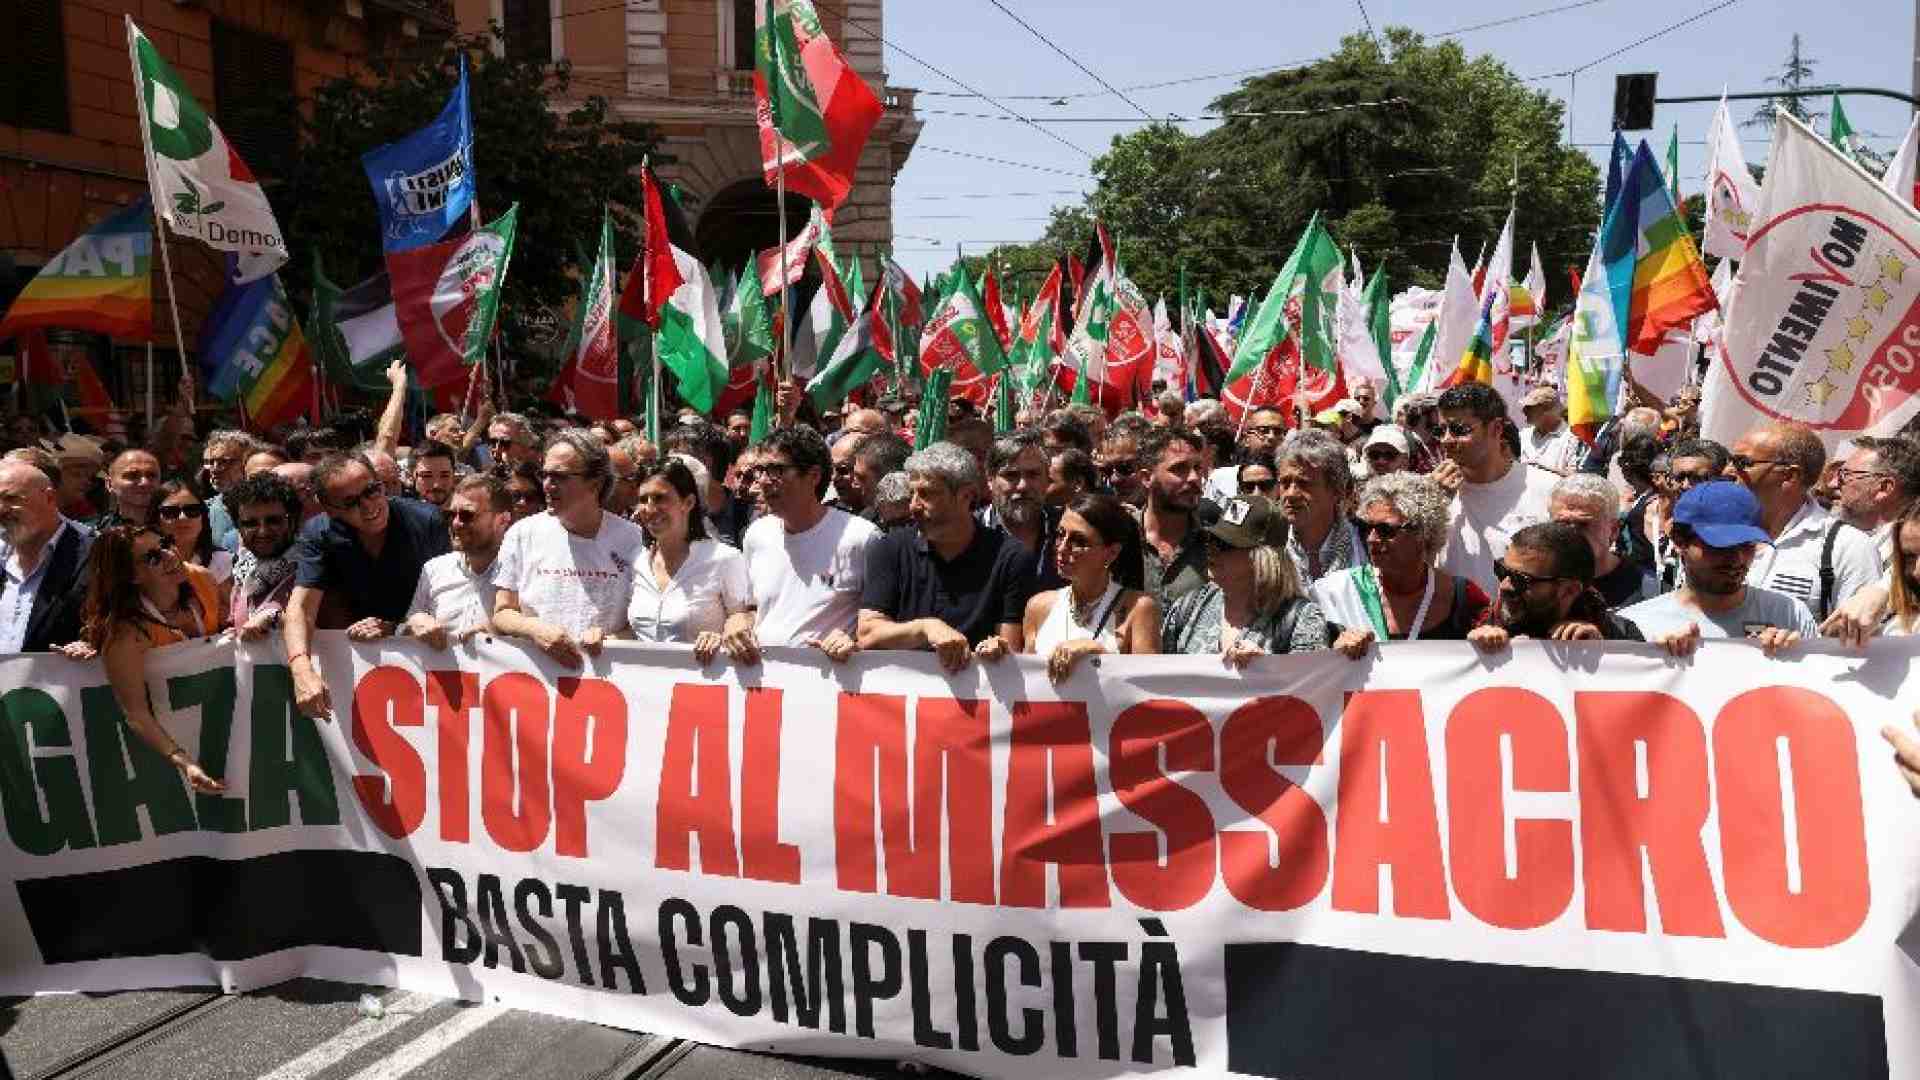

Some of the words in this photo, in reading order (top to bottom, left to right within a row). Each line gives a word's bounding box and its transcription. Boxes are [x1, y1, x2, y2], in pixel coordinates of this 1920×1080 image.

[0, 664, 340, 857] GAZA
[352, 665, 628, 858] STOP
[655, 683, 802, 885] AL
[834, 685, 1872, 949] MASSACRO
[426, 867, 646, 995] BASTA
[658, 898, 1197, 1069] COMPLICITÀ
